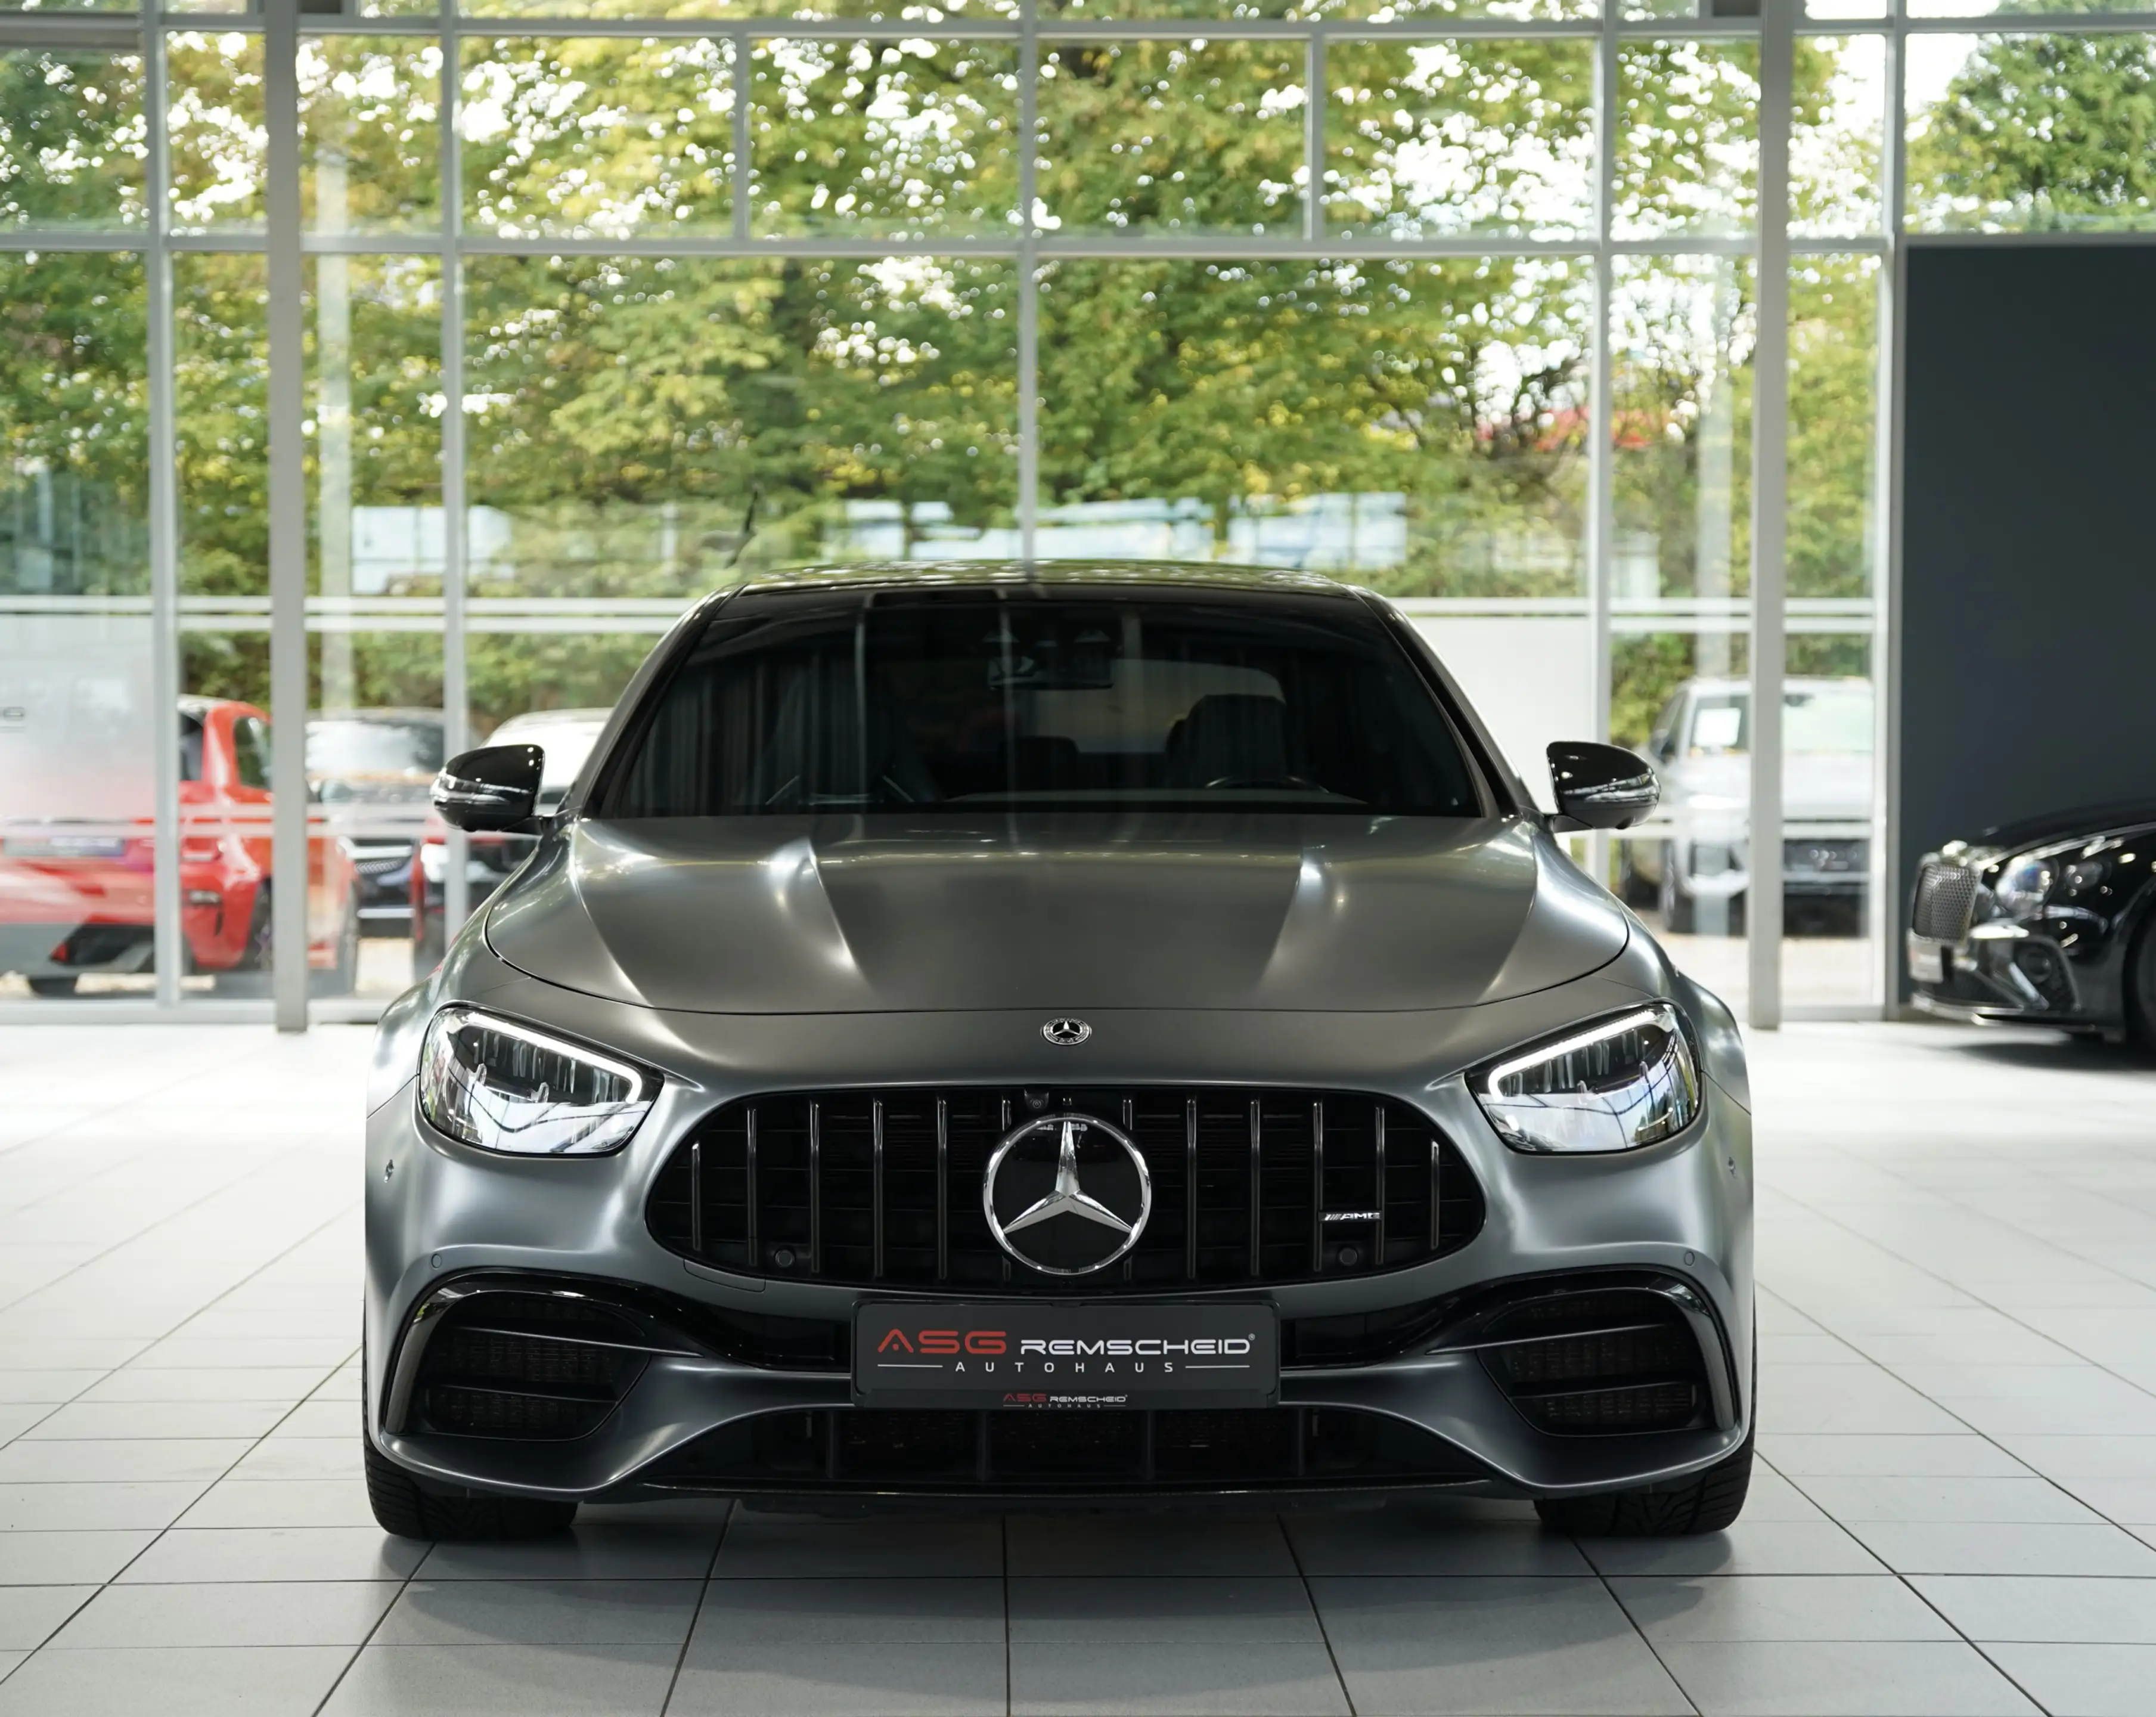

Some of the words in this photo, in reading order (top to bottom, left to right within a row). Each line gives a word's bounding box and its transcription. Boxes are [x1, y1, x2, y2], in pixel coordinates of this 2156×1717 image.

[877, 1329, 1007, 1355] ASG
[955, 1362, 1174, 1373] AUTOHAUS
[1003, 1393, 1047, 1403] ASG
